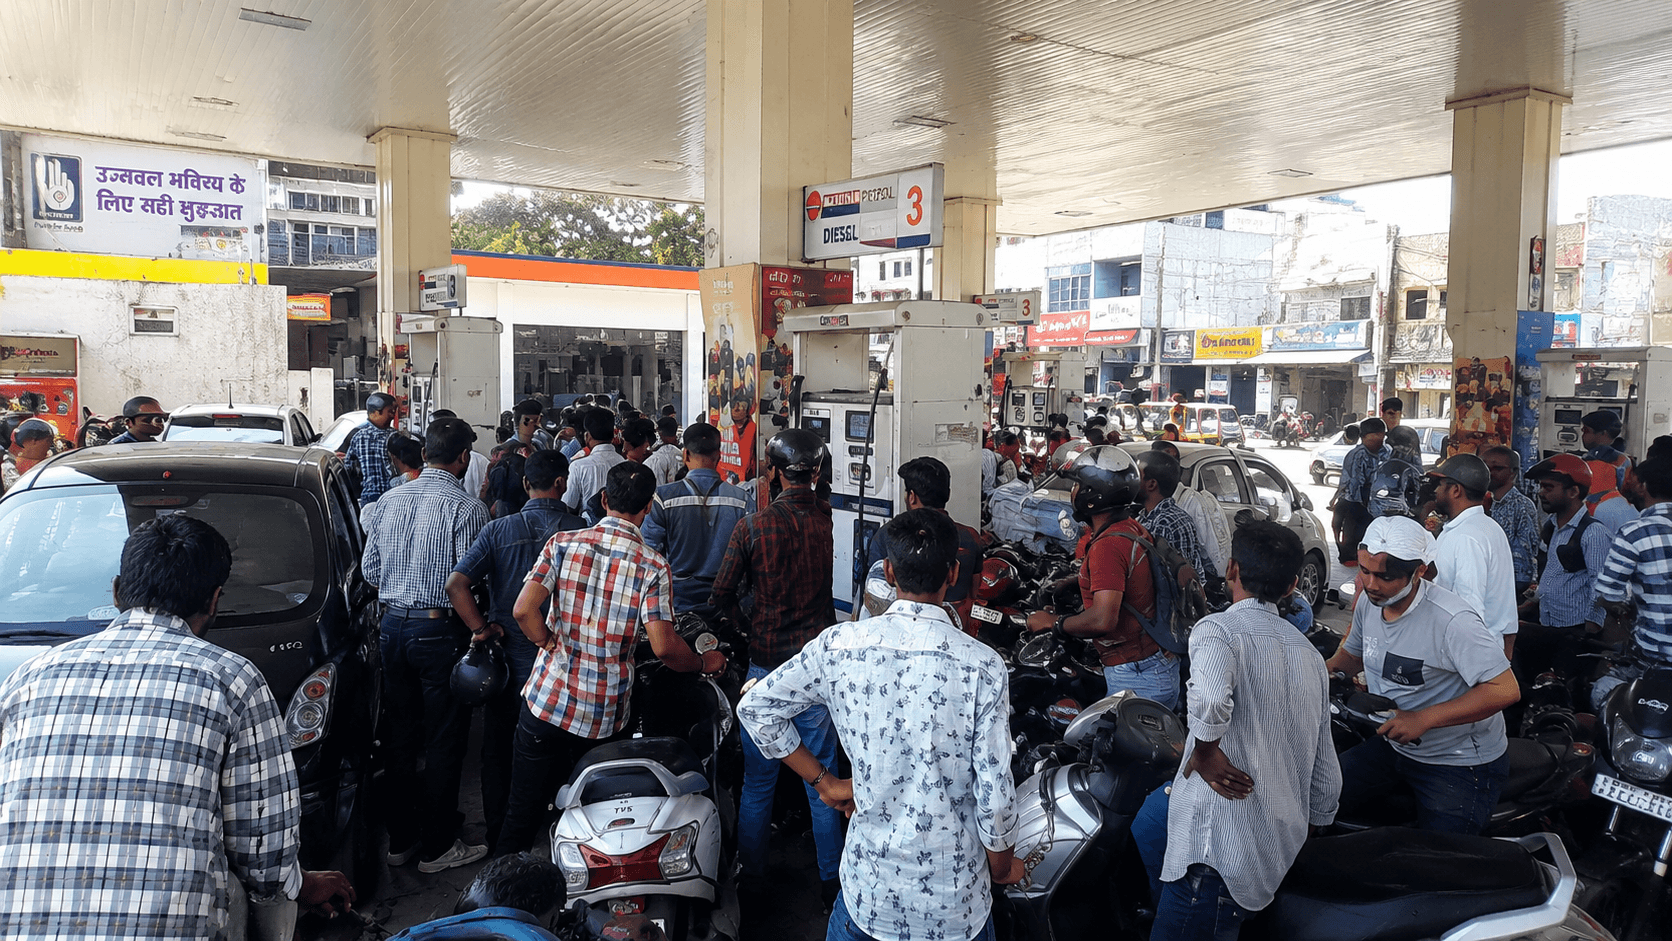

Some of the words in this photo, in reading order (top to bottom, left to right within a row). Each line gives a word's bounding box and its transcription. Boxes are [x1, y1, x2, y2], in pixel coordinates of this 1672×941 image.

[96, 188, 135, 212] लिए
[906, 185, 923, 226] 3
[1022, 298, 1031, 317] 3
